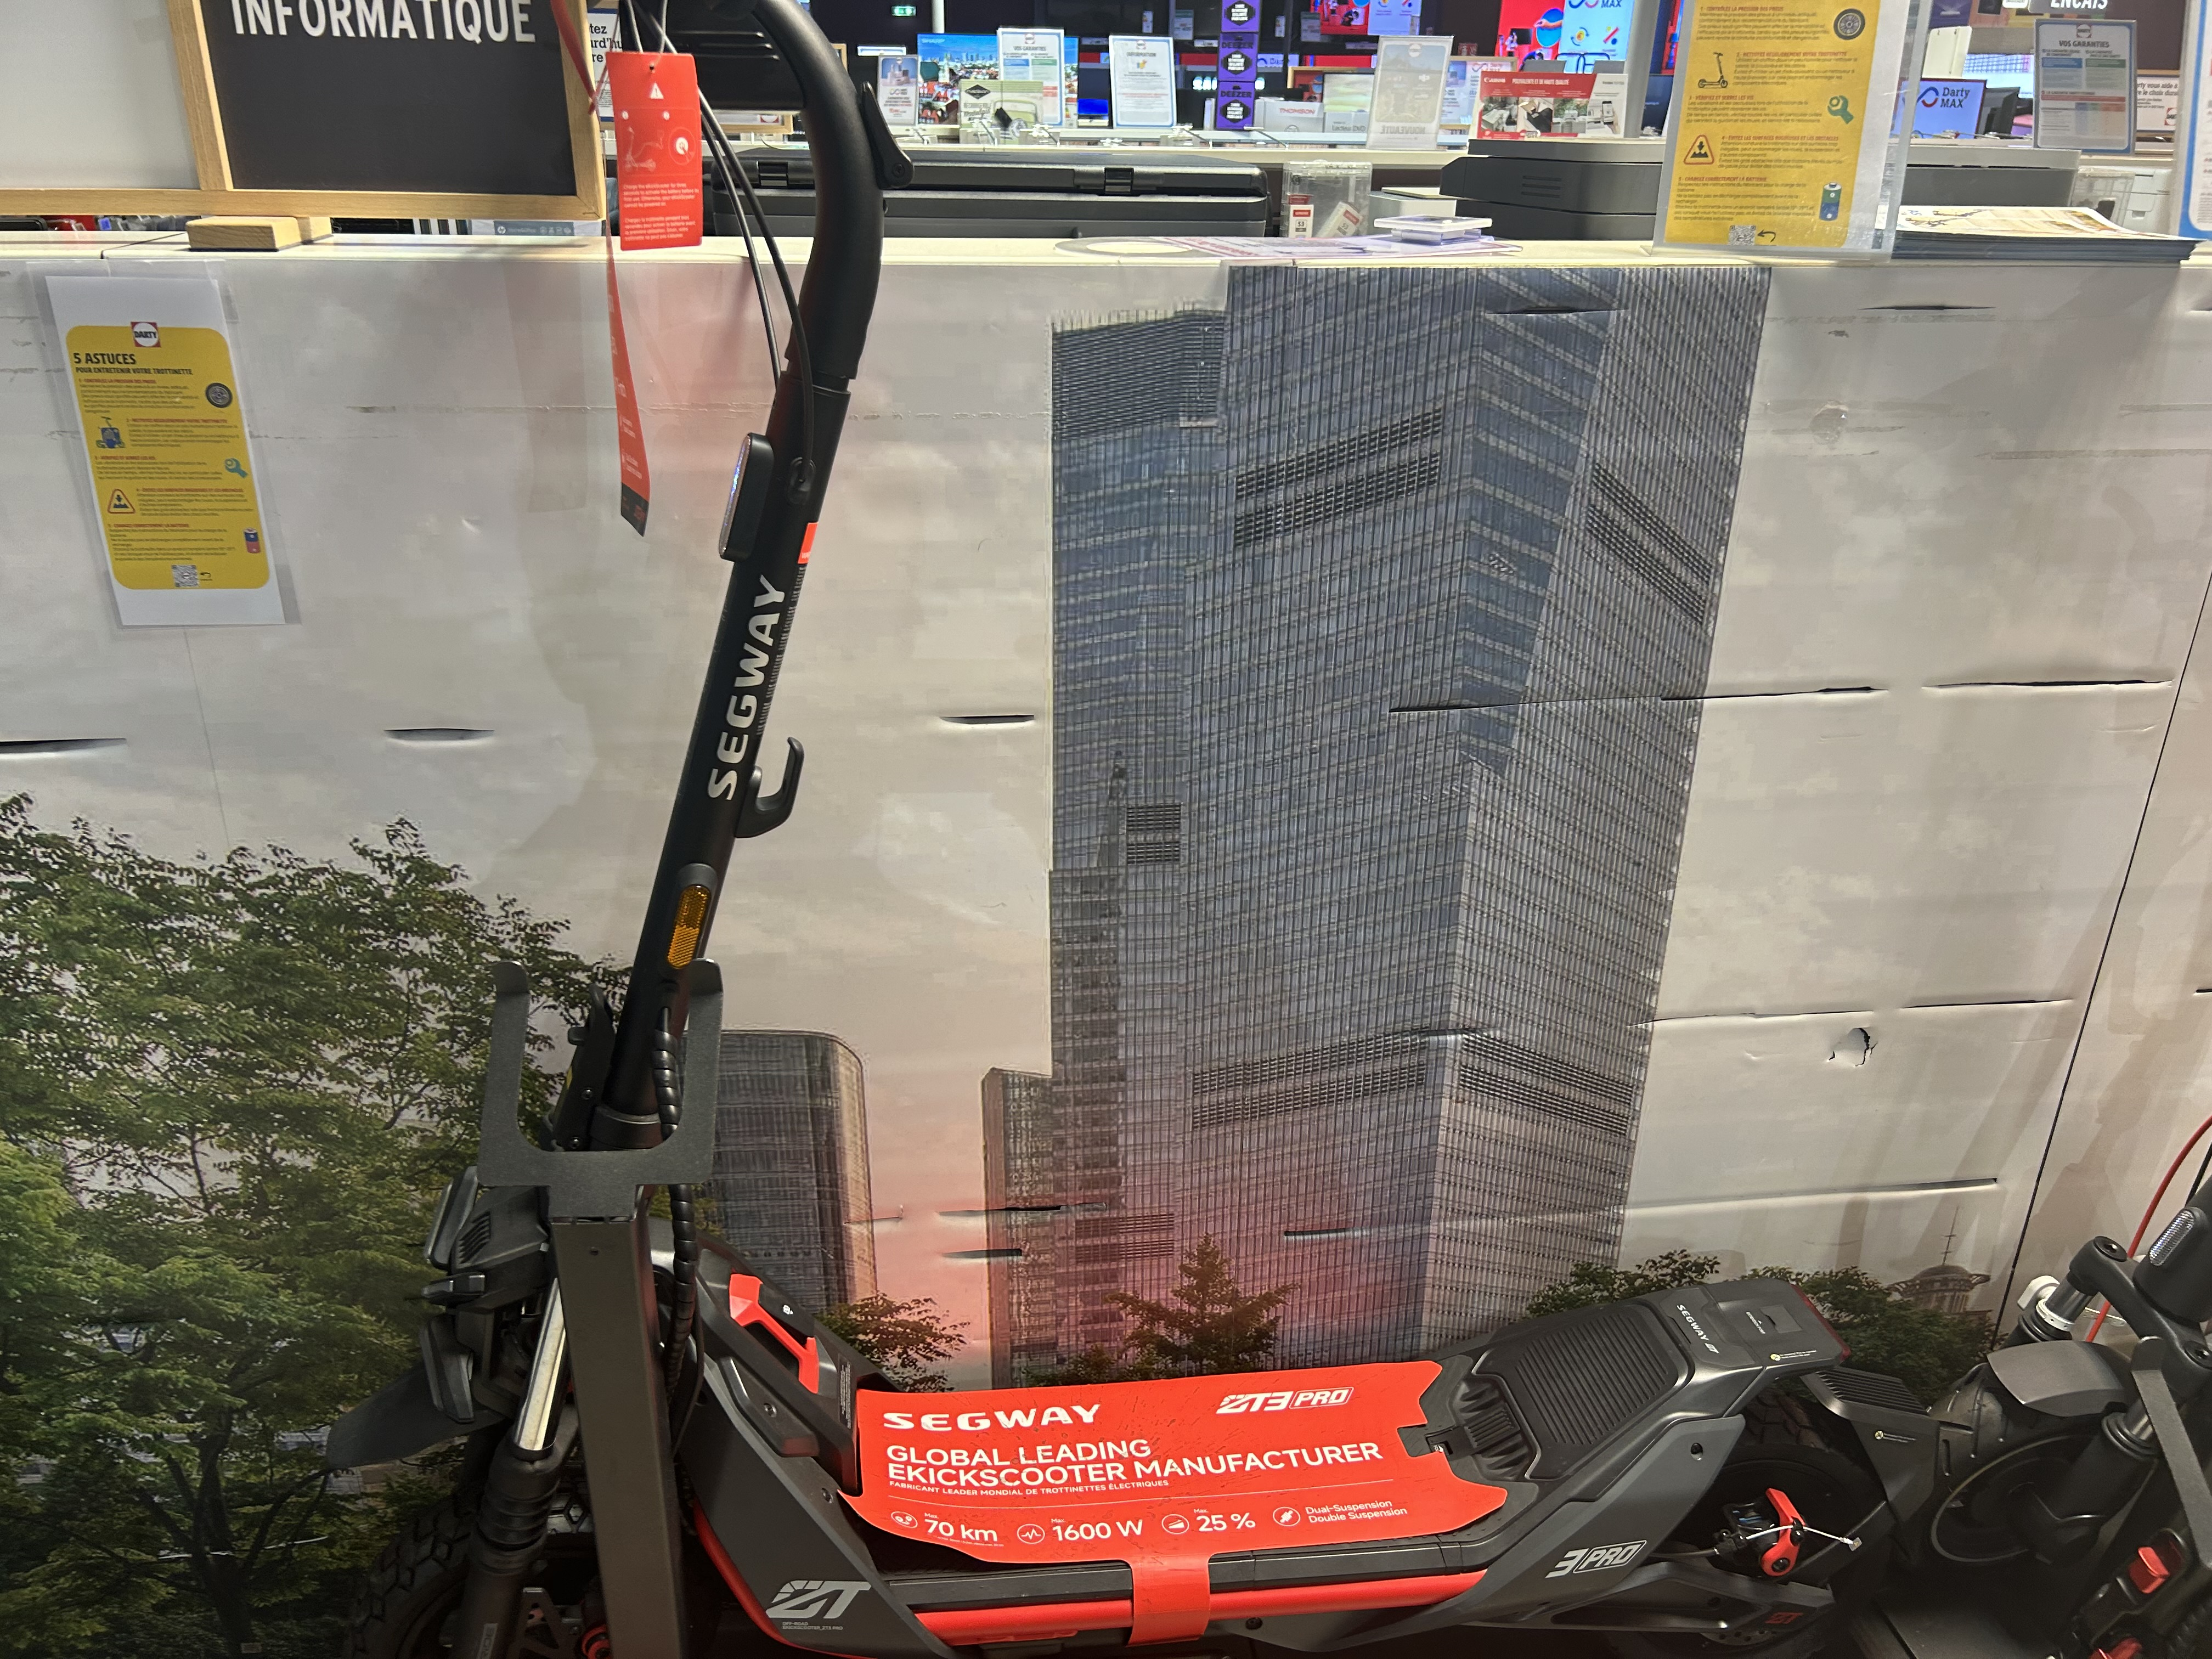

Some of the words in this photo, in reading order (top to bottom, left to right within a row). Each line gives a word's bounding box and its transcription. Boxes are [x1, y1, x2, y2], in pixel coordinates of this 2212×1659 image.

[231, 0, 535, 43] INFORMATIQUE
[1940, 99, 1962, 108] MAX
[1942, 87, 1970, 99] Darty
[74, 352, 81, 364] 5
[85, 353, 136, 365] ASTUCES
[708, 574, 785, 800] SEGWAY
[1677, 1304, 1709, 1341] SEGWAY
[1216, 1391, 1293, 1414] ZT3
[1294, 1389, 1350, 1407] PRO
[883, 1404, 1101, 1431] SEGWAY
[887, 1445, 1012, 1466] GLOBAL
[1019, 1439, 1152, 1464] LEADING
[888, 1462, 1127, 1487] EKICKSCOOTER
[1133, 1442, 1384, 1479] MANUFACTURER
[889, 1480, 940, 1492] FABRICANT
[1040, 1484, 1106, 1495] TROTTINETTES
[1109, 1480, 1169, 1491] ÉLECTRIQUES
[1305, 1500, 1392, 1514] Dual-Suspension
[1309, 1511, 1346, 1523] Double
[1349, 1507, 1407, 1520] Suspension
[924, 1519, 954, 1536] 70
[961, 1524, 997, 1542] km
[1053, 1522, 1111, 1541] 1600
[1116, 1519, 1143, 1537] W
[1196, 1514, 1227, 1532] 25
[1231, 1513, 1256, 1529] %
[1545, 1548, 1589, 1578] 3
[1578, 1543, 1642, 1570] PRO
